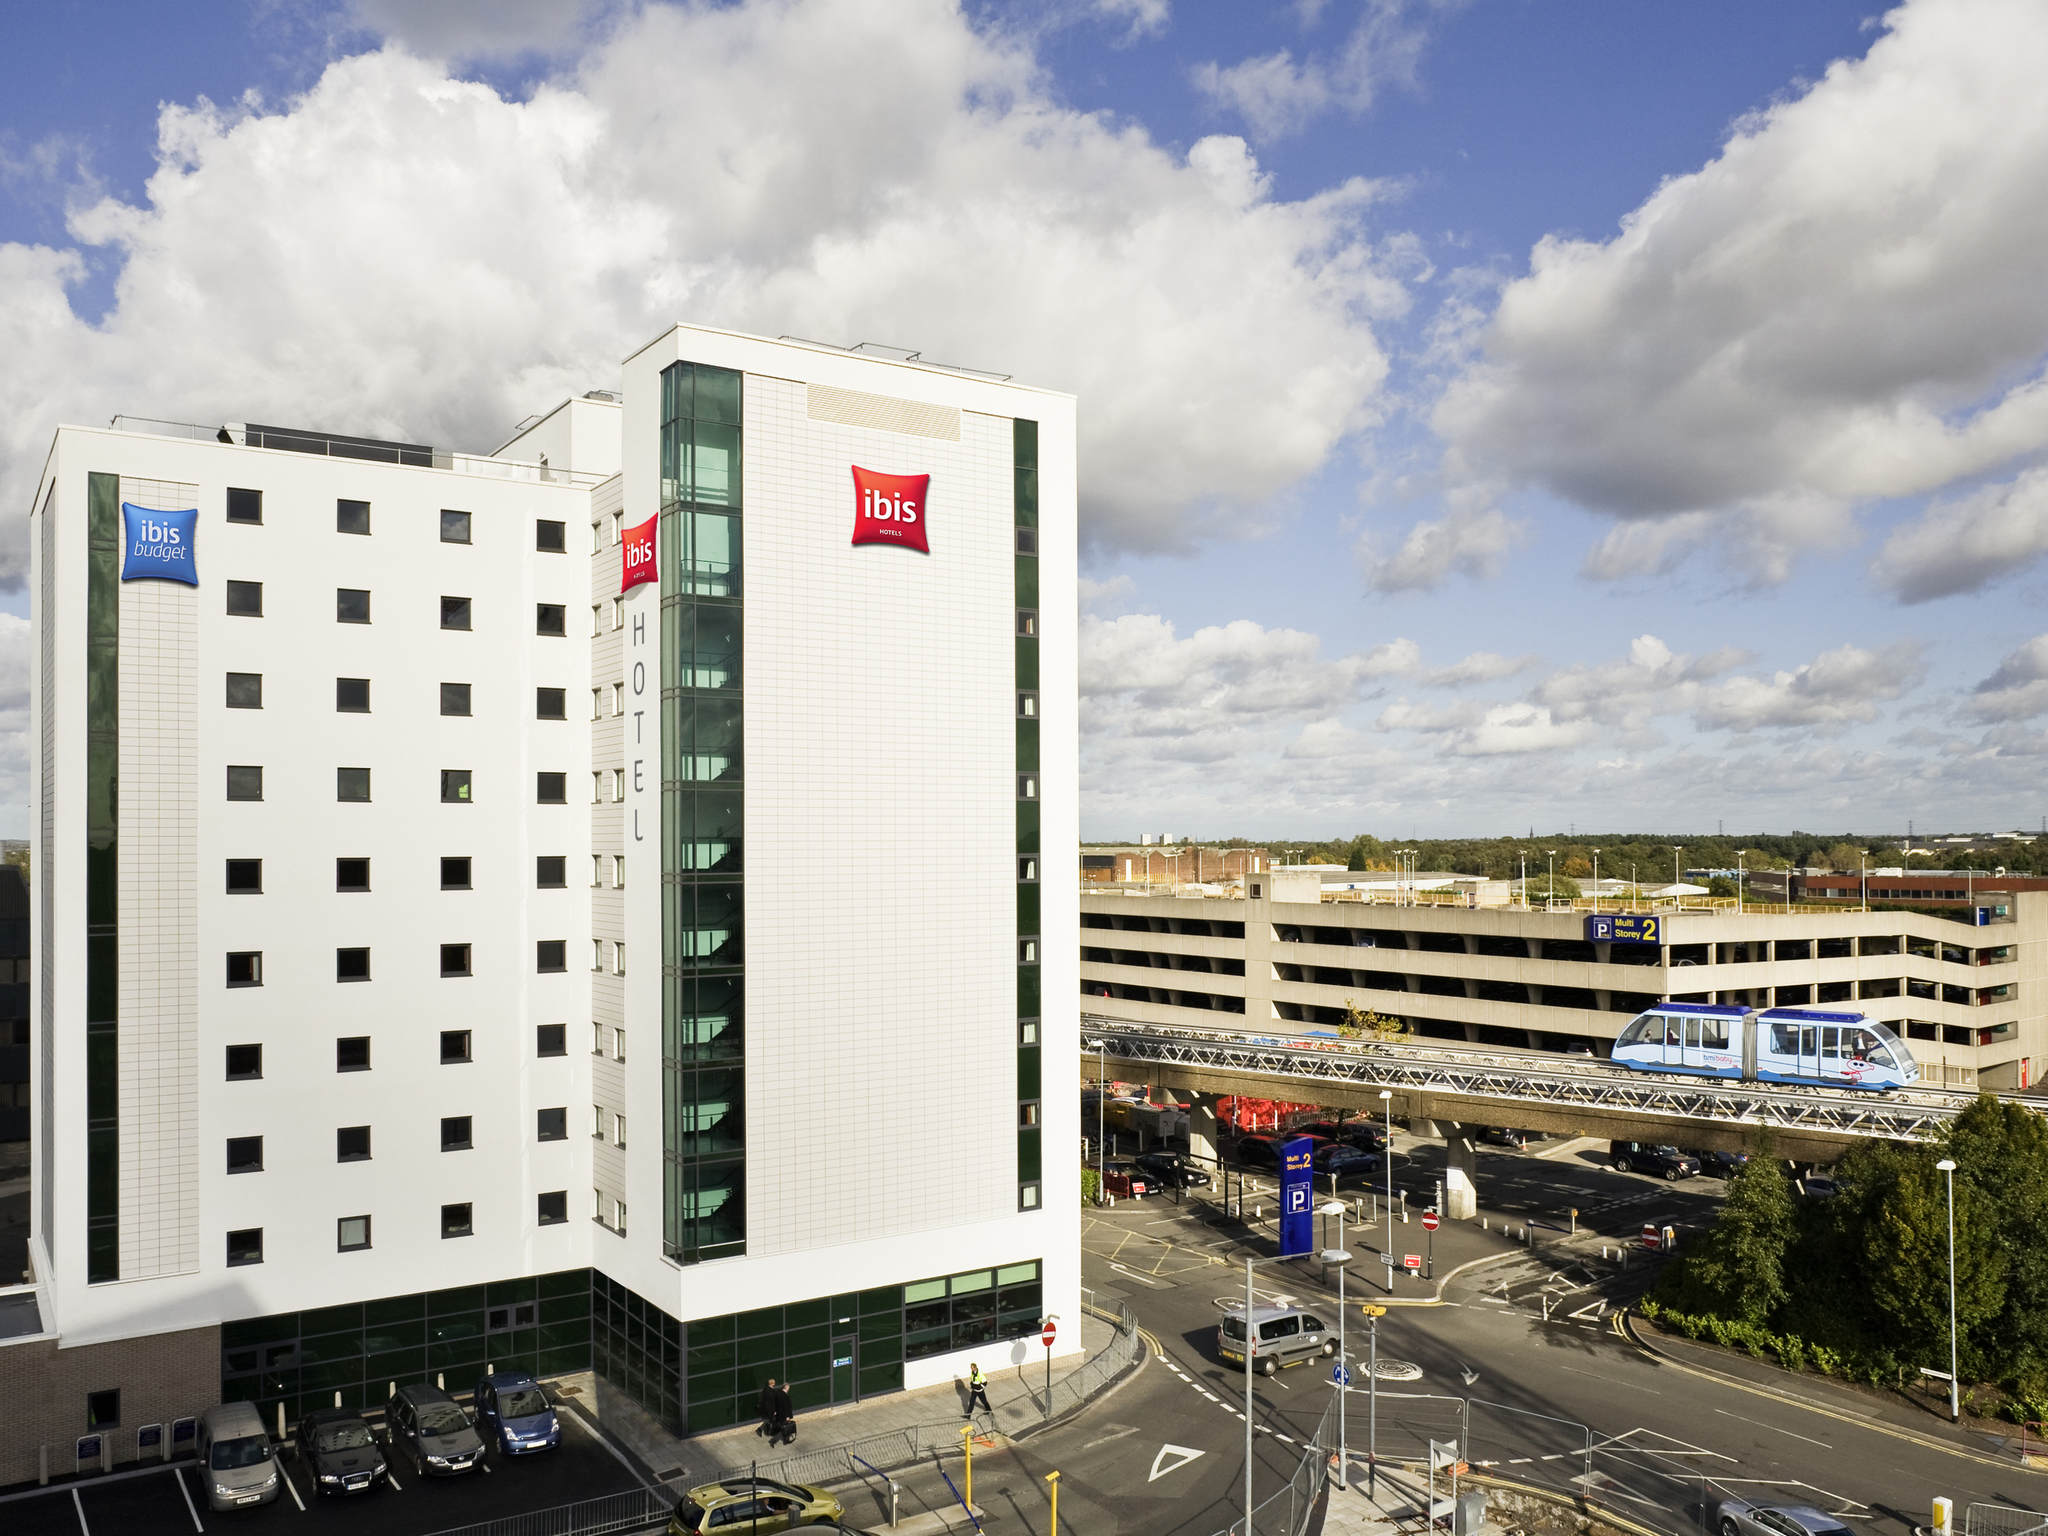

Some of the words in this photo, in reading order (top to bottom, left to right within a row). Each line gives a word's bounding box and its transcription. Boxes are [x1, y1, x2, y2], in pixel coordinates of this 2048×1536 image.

[864, 488, 917, 523] ibis
[141, 519, 180, 544] ibis
[879, 528, 902, 536] HOTELS
[134, 540, 187, 562] budget
[626, 538, 652, 568] ibis
[633, 611, 645, 842] HOTEL
[1597, 924, 1608, 938] P
[1614, 918, 1634, 927] Multi
[1642, 919, 1656, 940] 2
[1614, 929, 1641, 940] Storey
[1303, 1152, 1312, 1168] 2
[1292, 1190, 1305, 1211] P
